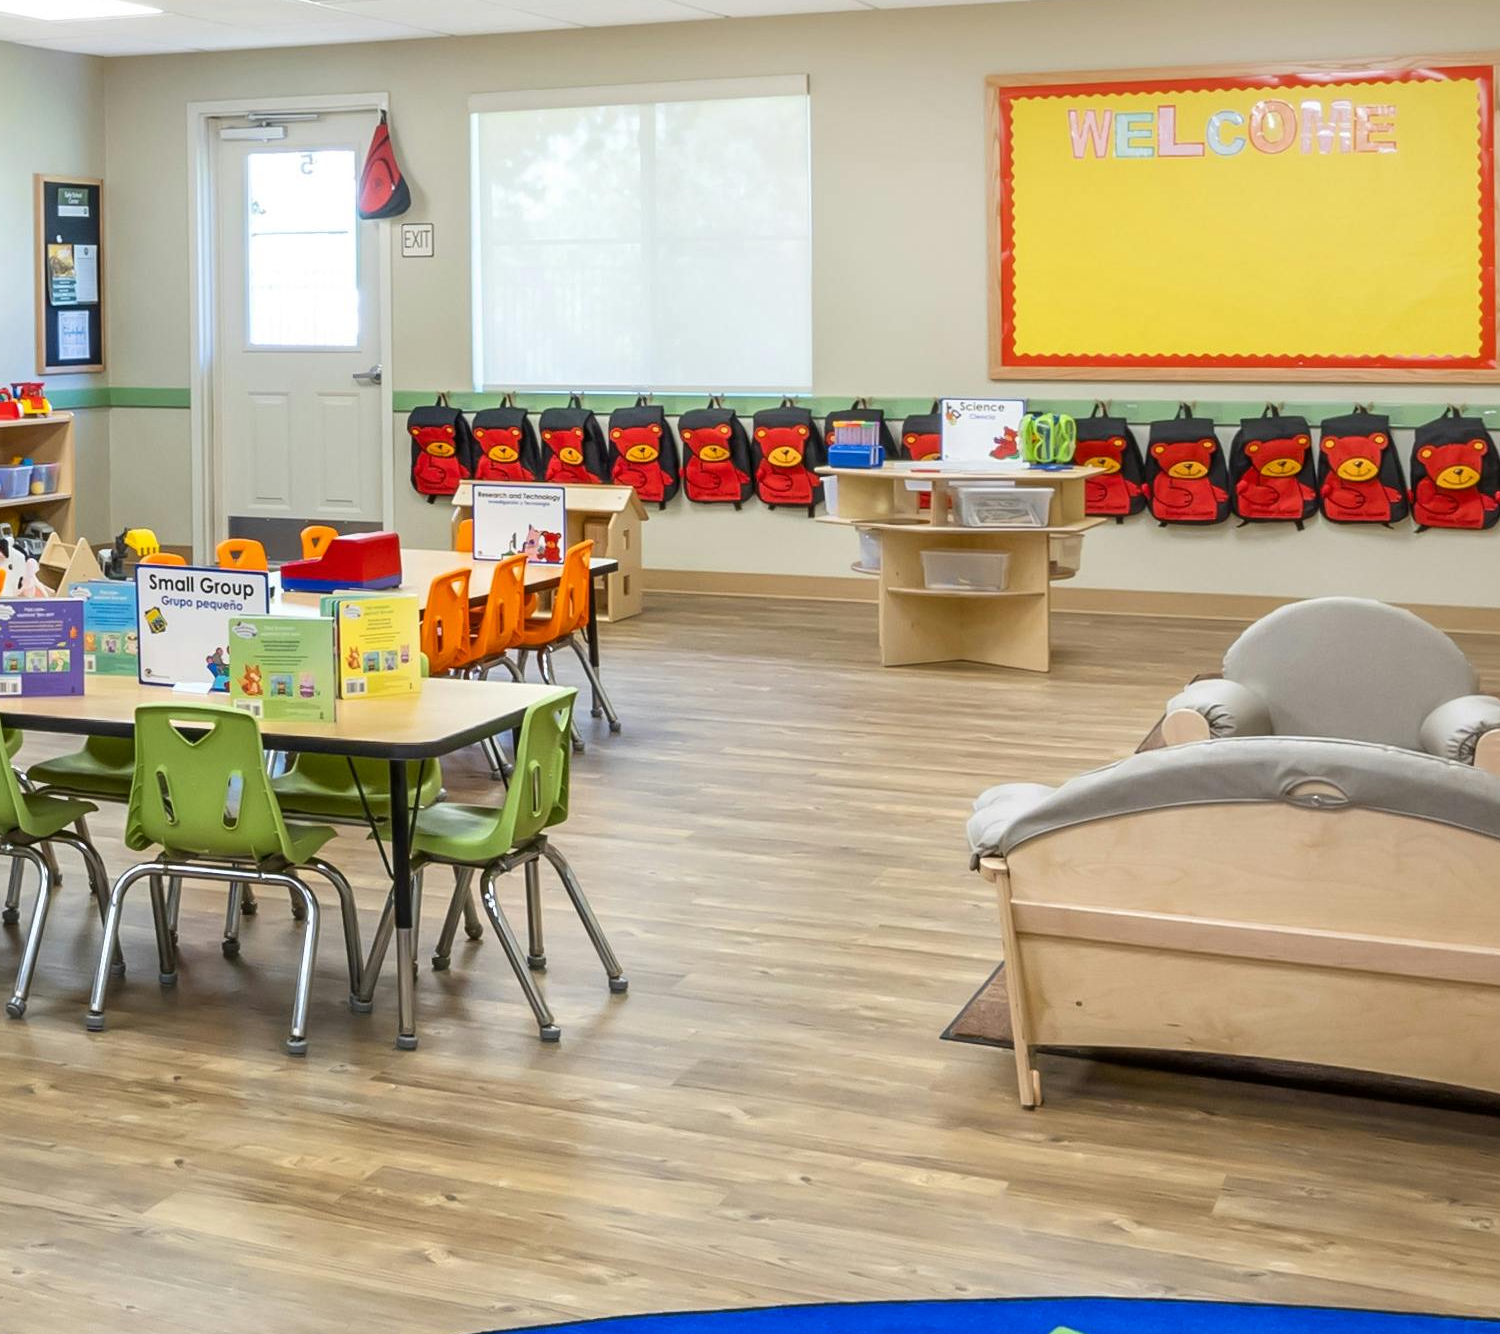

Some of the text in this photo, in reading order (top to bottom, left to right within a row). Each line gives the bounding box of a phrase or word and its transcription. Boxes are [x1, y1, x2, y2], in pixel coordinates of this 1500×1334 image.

[1067, 98, 1398, 159] WELCOME
[404, 229, 431, 249] EXIT
[959, 401, 1005, 413] Science
[478, 491, 508, 499] Research
[523, 492, 561, 502] Technology
[149, 574, 255, 600] Small Group
[160, 595, 243, 612] Grupo pequeño
